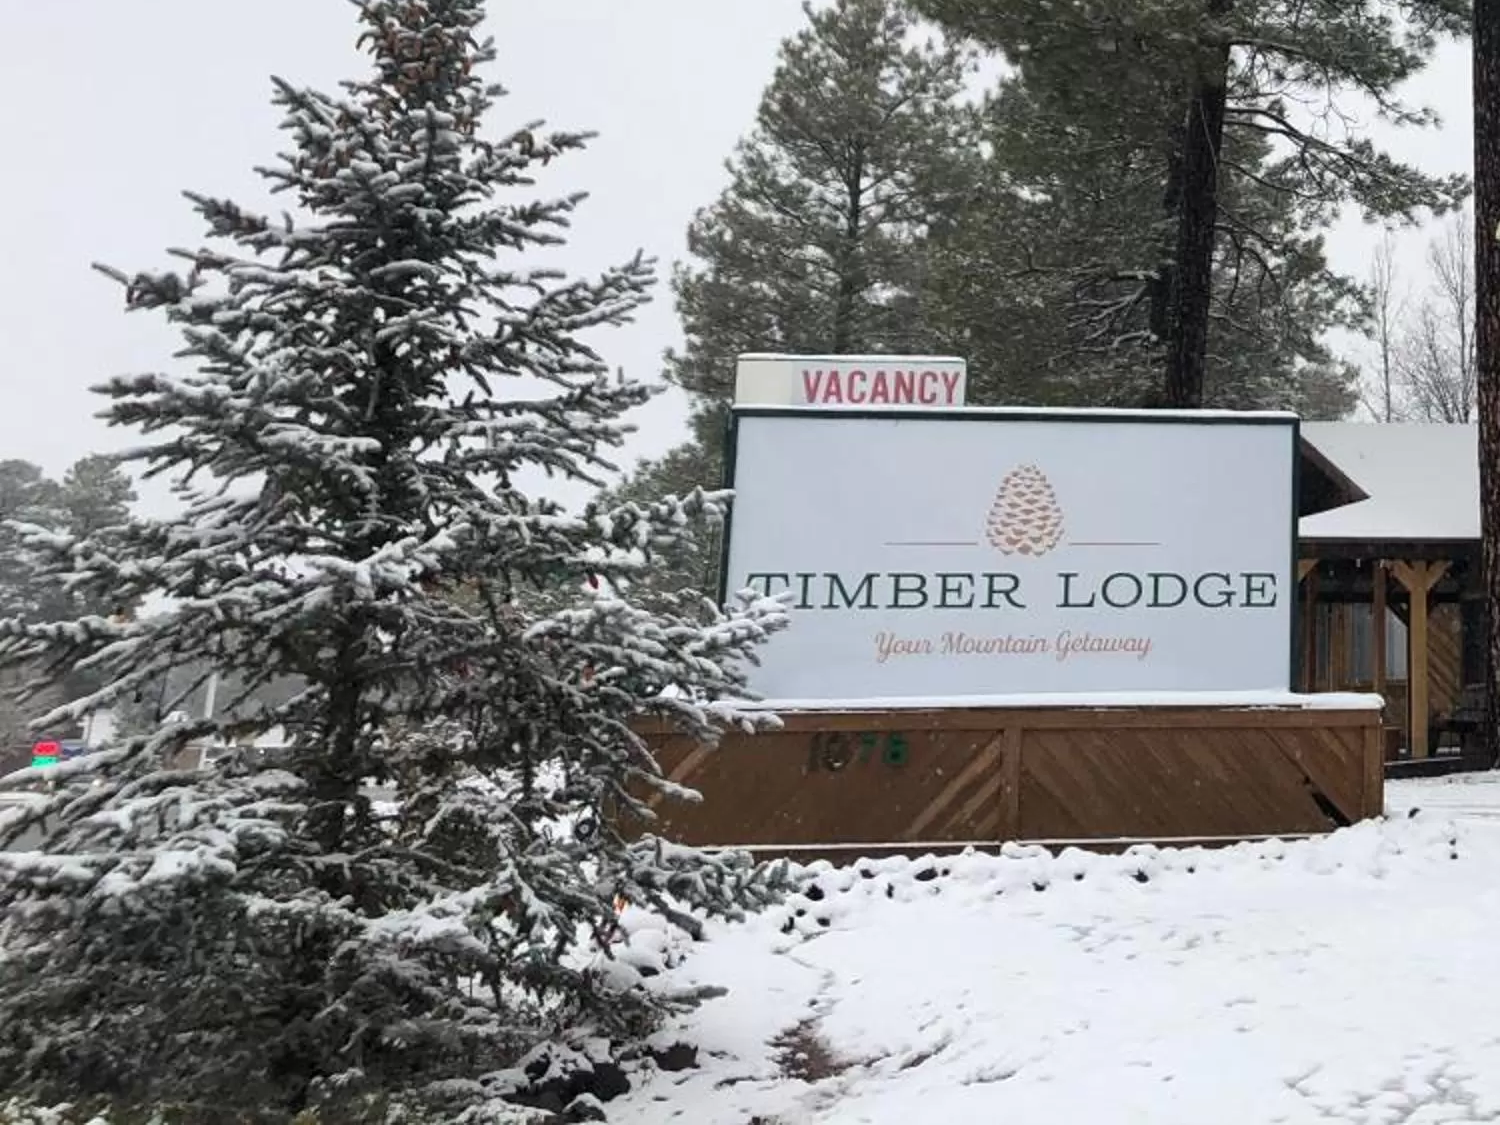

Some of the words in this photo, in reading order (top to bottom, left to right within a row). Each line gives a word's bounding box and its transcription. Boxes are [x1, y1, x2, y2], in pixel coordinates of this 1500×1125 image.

[801, 369, 961, 404] VACANCY
[745, 571, 1027, 610] TIMBER
[1055, 571, 1279, 608] LODGE
[874, 631, 933, 664] Your
[940, 631, 1049, 655] Mountain
[1055, 630, 1153, 662] Getaway
